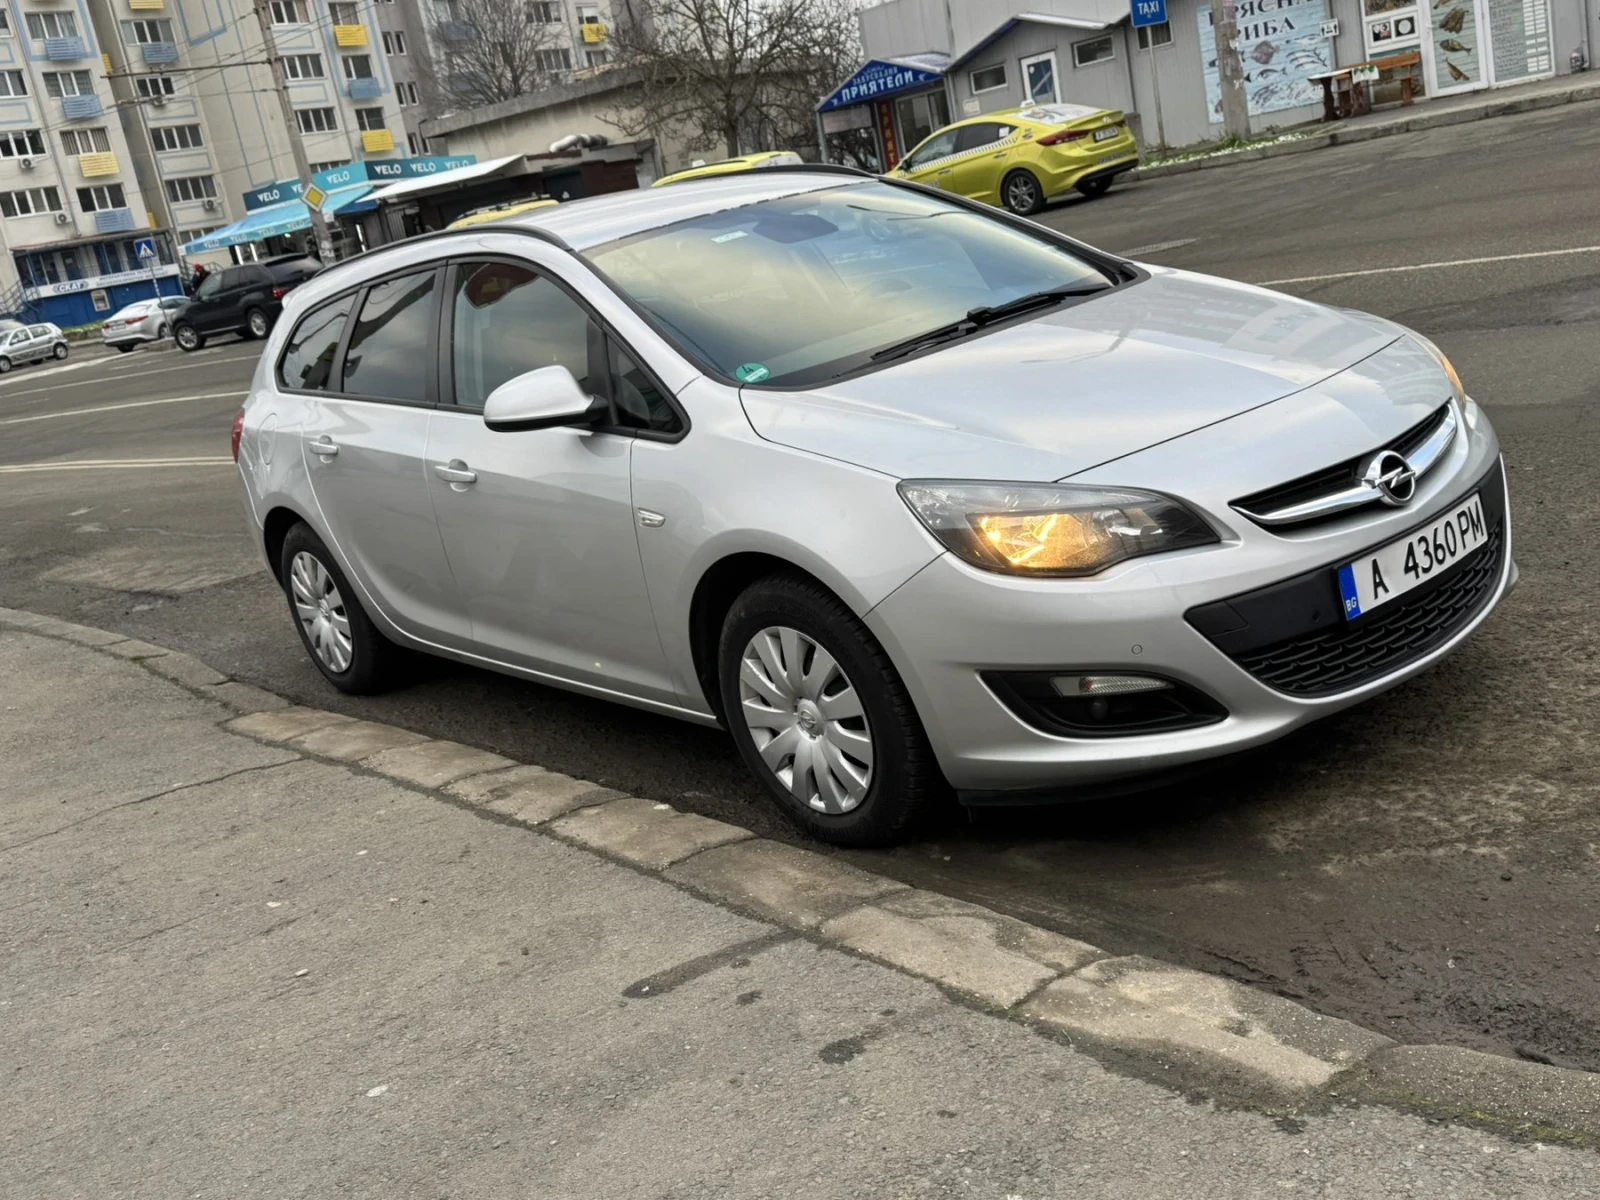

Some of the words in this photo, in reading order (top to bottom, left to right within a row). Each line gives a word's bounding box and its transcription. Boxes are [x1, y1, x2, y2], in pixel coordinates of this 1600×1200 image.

[1137, 0, 1160, 15] TAXI
[1237, 16, 1296, 41] ИБА
[841, 70, 914, 102] ПРИЯТЕЛИ
[374, 164, 402, 175] VELO
[410, 162, 437, 173] VELO
[257, 189, 280, 202] VELO
[291, 183, 303, 194] VE
[326, 171, 350, 184] VELO
[1345, 596, 1357, 612] BG
[1371, 558, 1390, 600] A
[1403, 520, 1458, 580] 4360
[1456, 500, 1485, 550] PM
